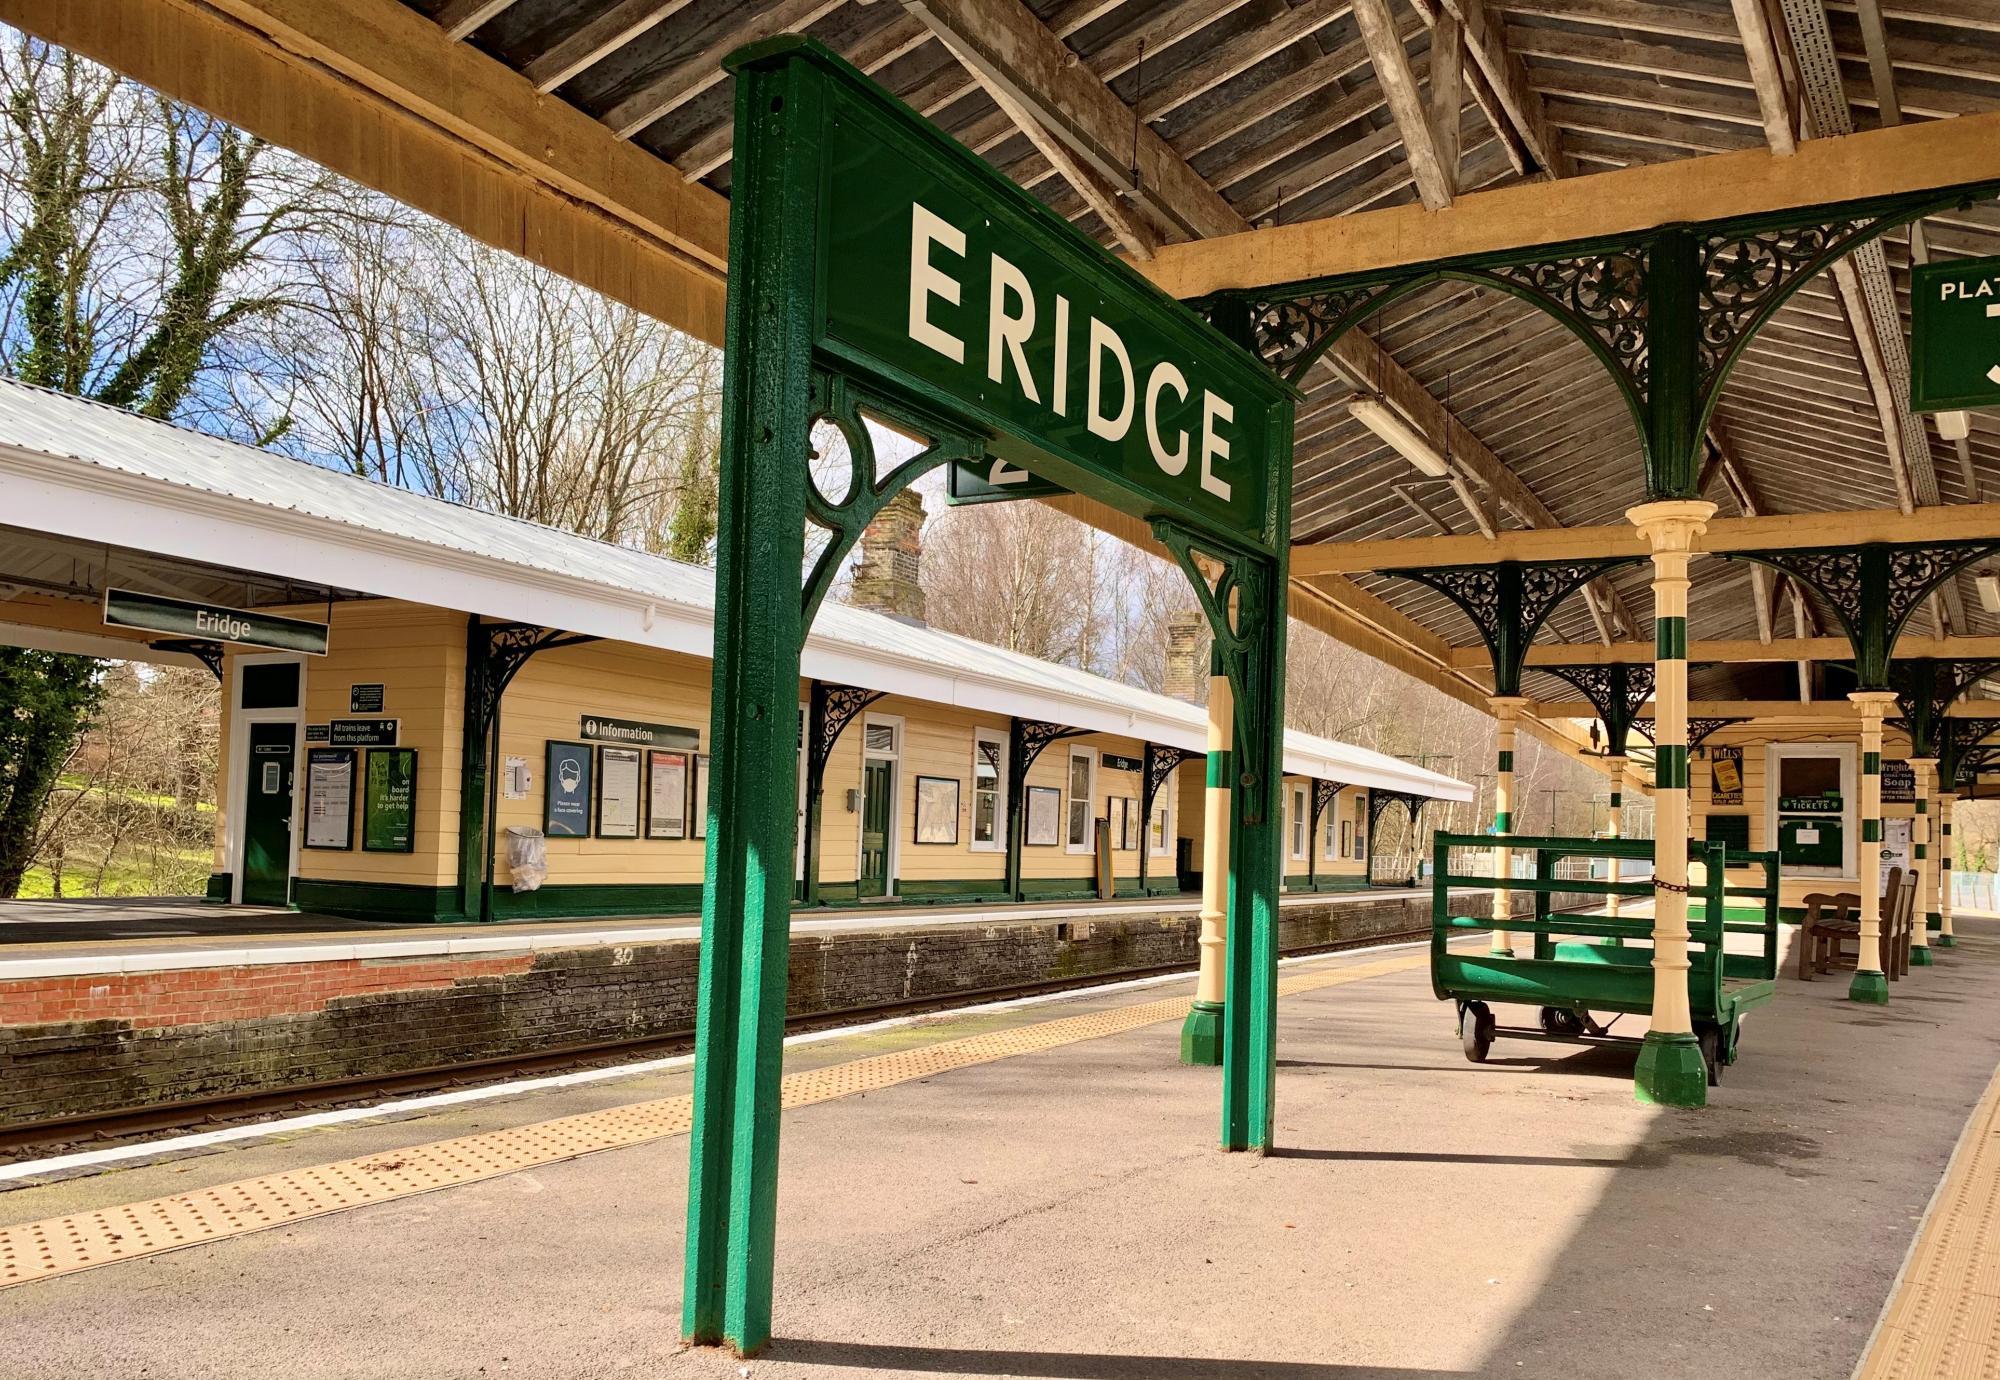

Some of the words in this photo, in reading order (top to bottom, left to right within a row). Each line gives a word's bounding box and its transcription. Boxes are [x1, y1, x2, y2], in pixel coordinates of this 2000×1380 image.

[909, 201, 1234, 502] ERIDGE
[196, 610, 251, 640] Eridge
[342, 724, 356, 732] trains
[357, 724, 370, 732] leave
[599, 721, 653, 741] Information
[334, 734, 346, 742] from
[347, 734, 356, 742] this
[357, 733, 379, 743] platform
[392, 785, 410, 793] board
[1884, 778, 1911, 790] Soap
[390, 793, 408, 801] harder
[385, 803, 395, 811] get
[396, 802, 409, 811] help
